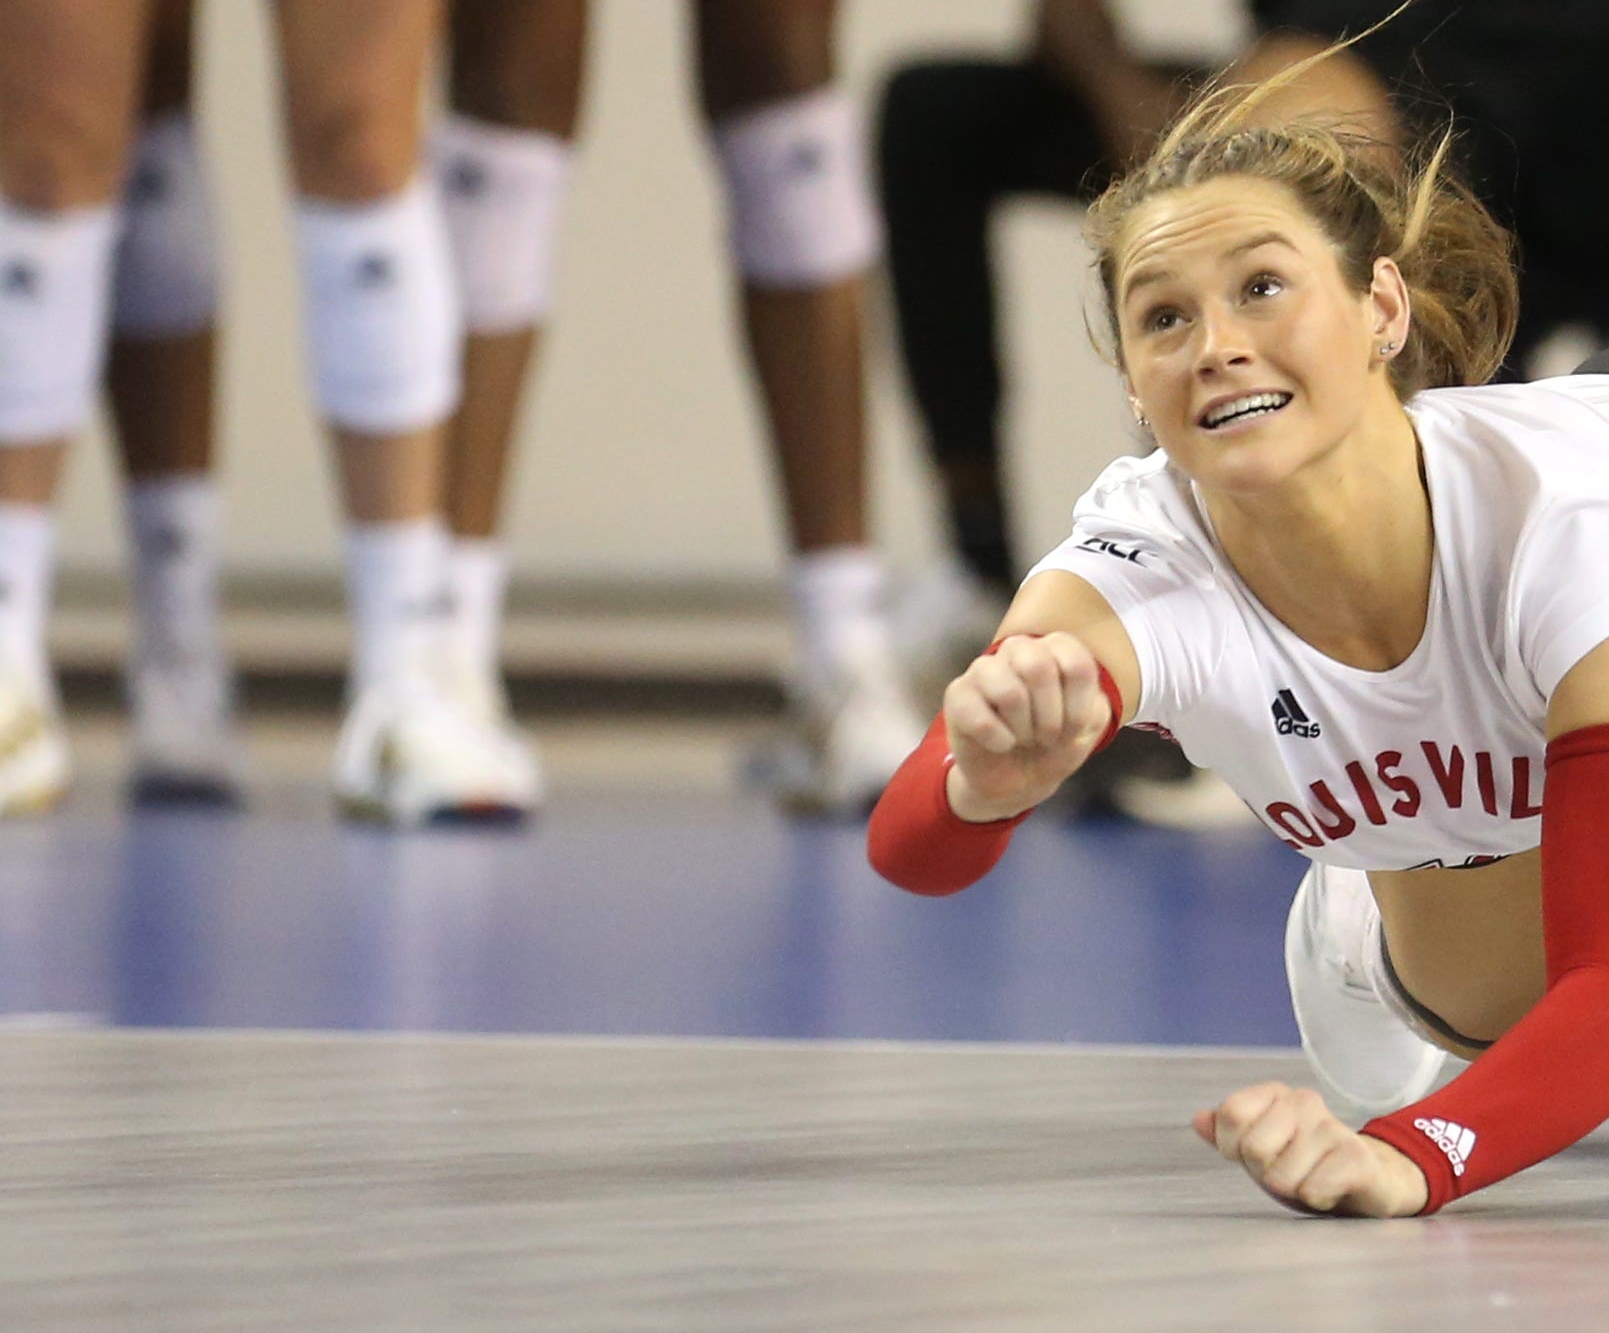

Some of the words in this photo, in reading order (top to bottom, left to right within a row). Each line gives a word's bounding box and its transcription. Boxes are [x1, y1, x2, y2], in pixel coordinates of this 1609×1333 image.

[1276, 716, 1321, 739] das
[1264, 741, 1543, 850] OUISVIL
[1413, 1117, 1466, 1177] adidas
